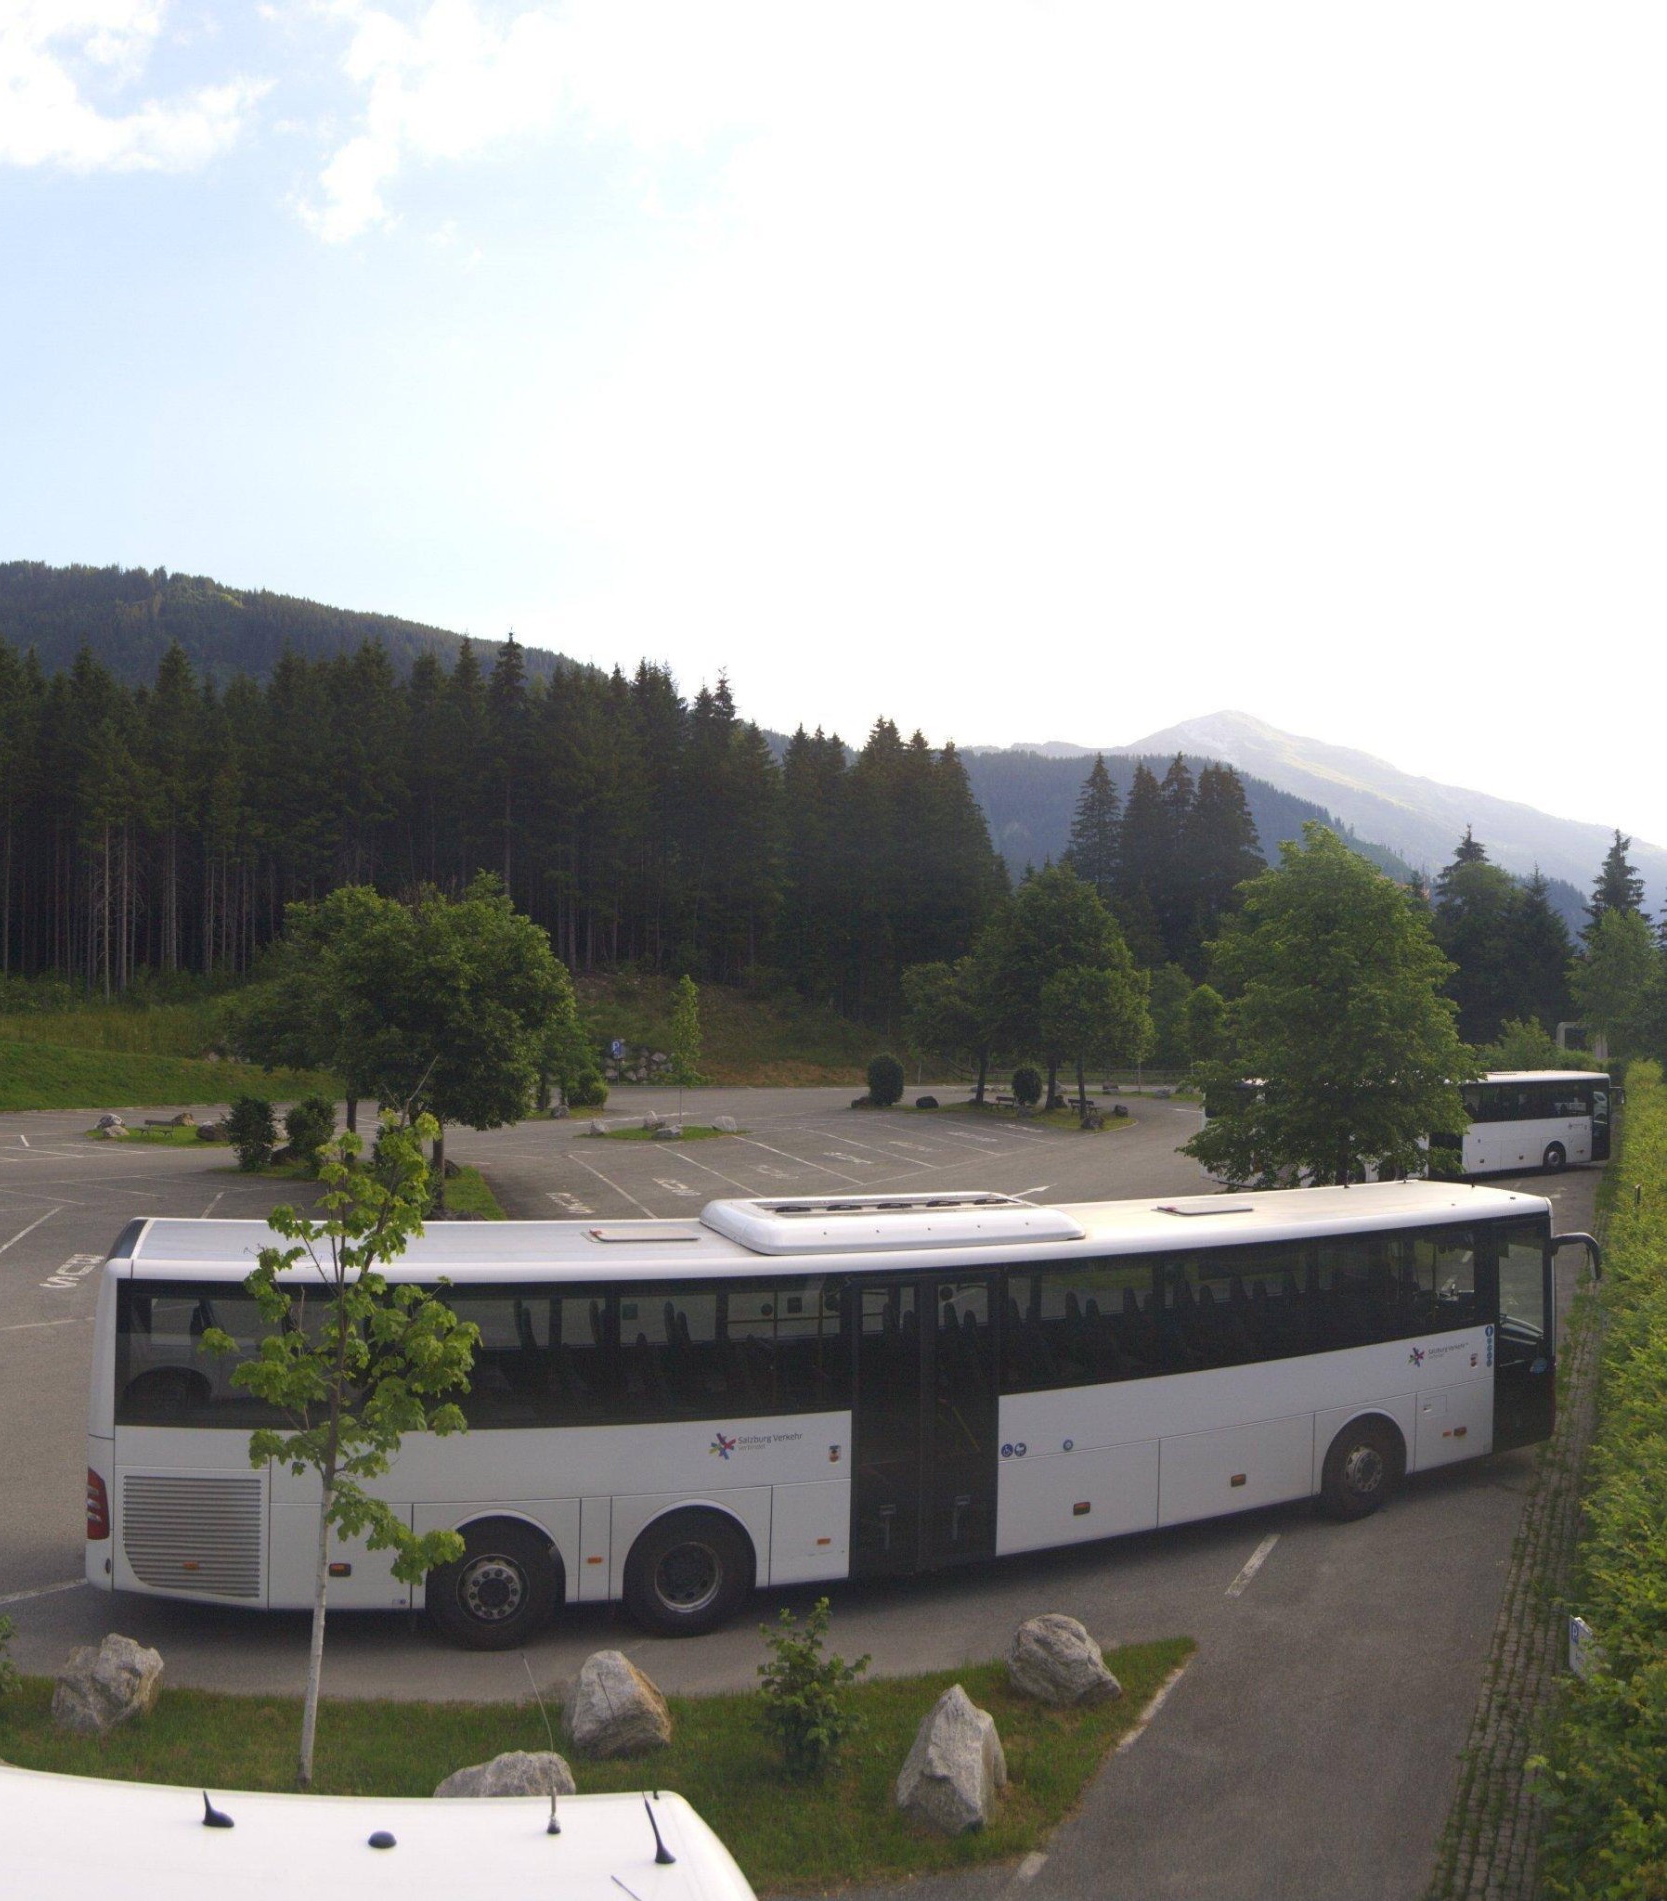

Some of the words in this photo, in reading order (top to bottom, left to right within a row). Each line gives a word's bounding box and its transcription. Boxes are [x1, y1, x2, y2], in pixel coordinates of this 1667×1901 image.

[39, 1253, 106, 1289] BUS
[738, 1434, 772, 1444] Salzburg
[773, 1432, 803, 1442] Verkehr
